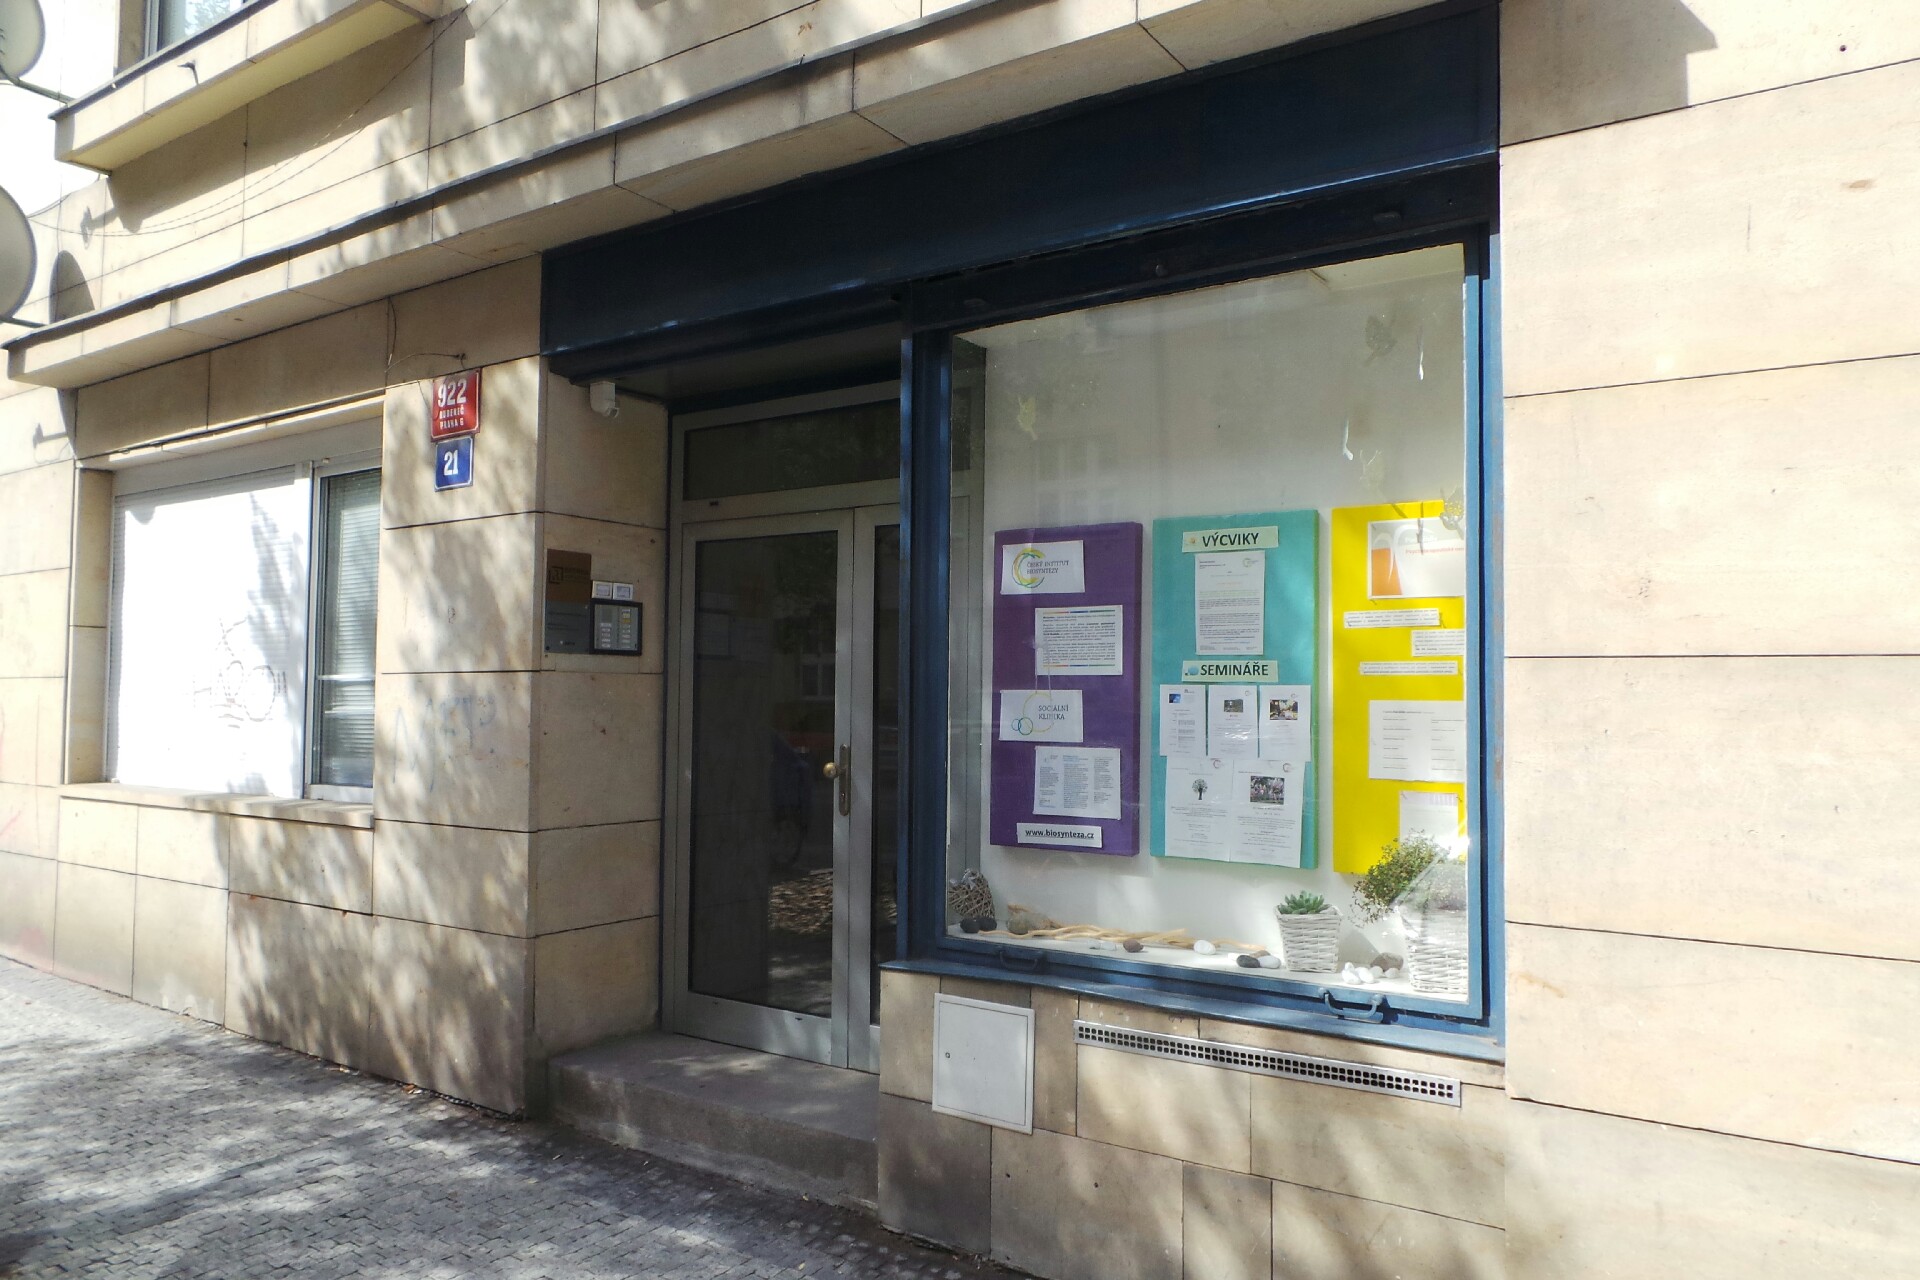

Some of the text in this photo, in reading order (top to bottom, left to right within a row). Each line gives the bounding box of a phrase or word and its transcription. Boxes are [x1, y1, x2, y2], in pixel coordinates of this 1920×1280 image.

[437, 379, 467, 407] 922
[439, 418, 459, 430] PRAHA
[443, 449, 459, 476] 21
[1202, 532, 1259, 547] VÝCVIKY
[1200, 661, 1269, 676] SEMINÁŘE
[1025, 828, 1095, 840] www.biosynteza.cz
